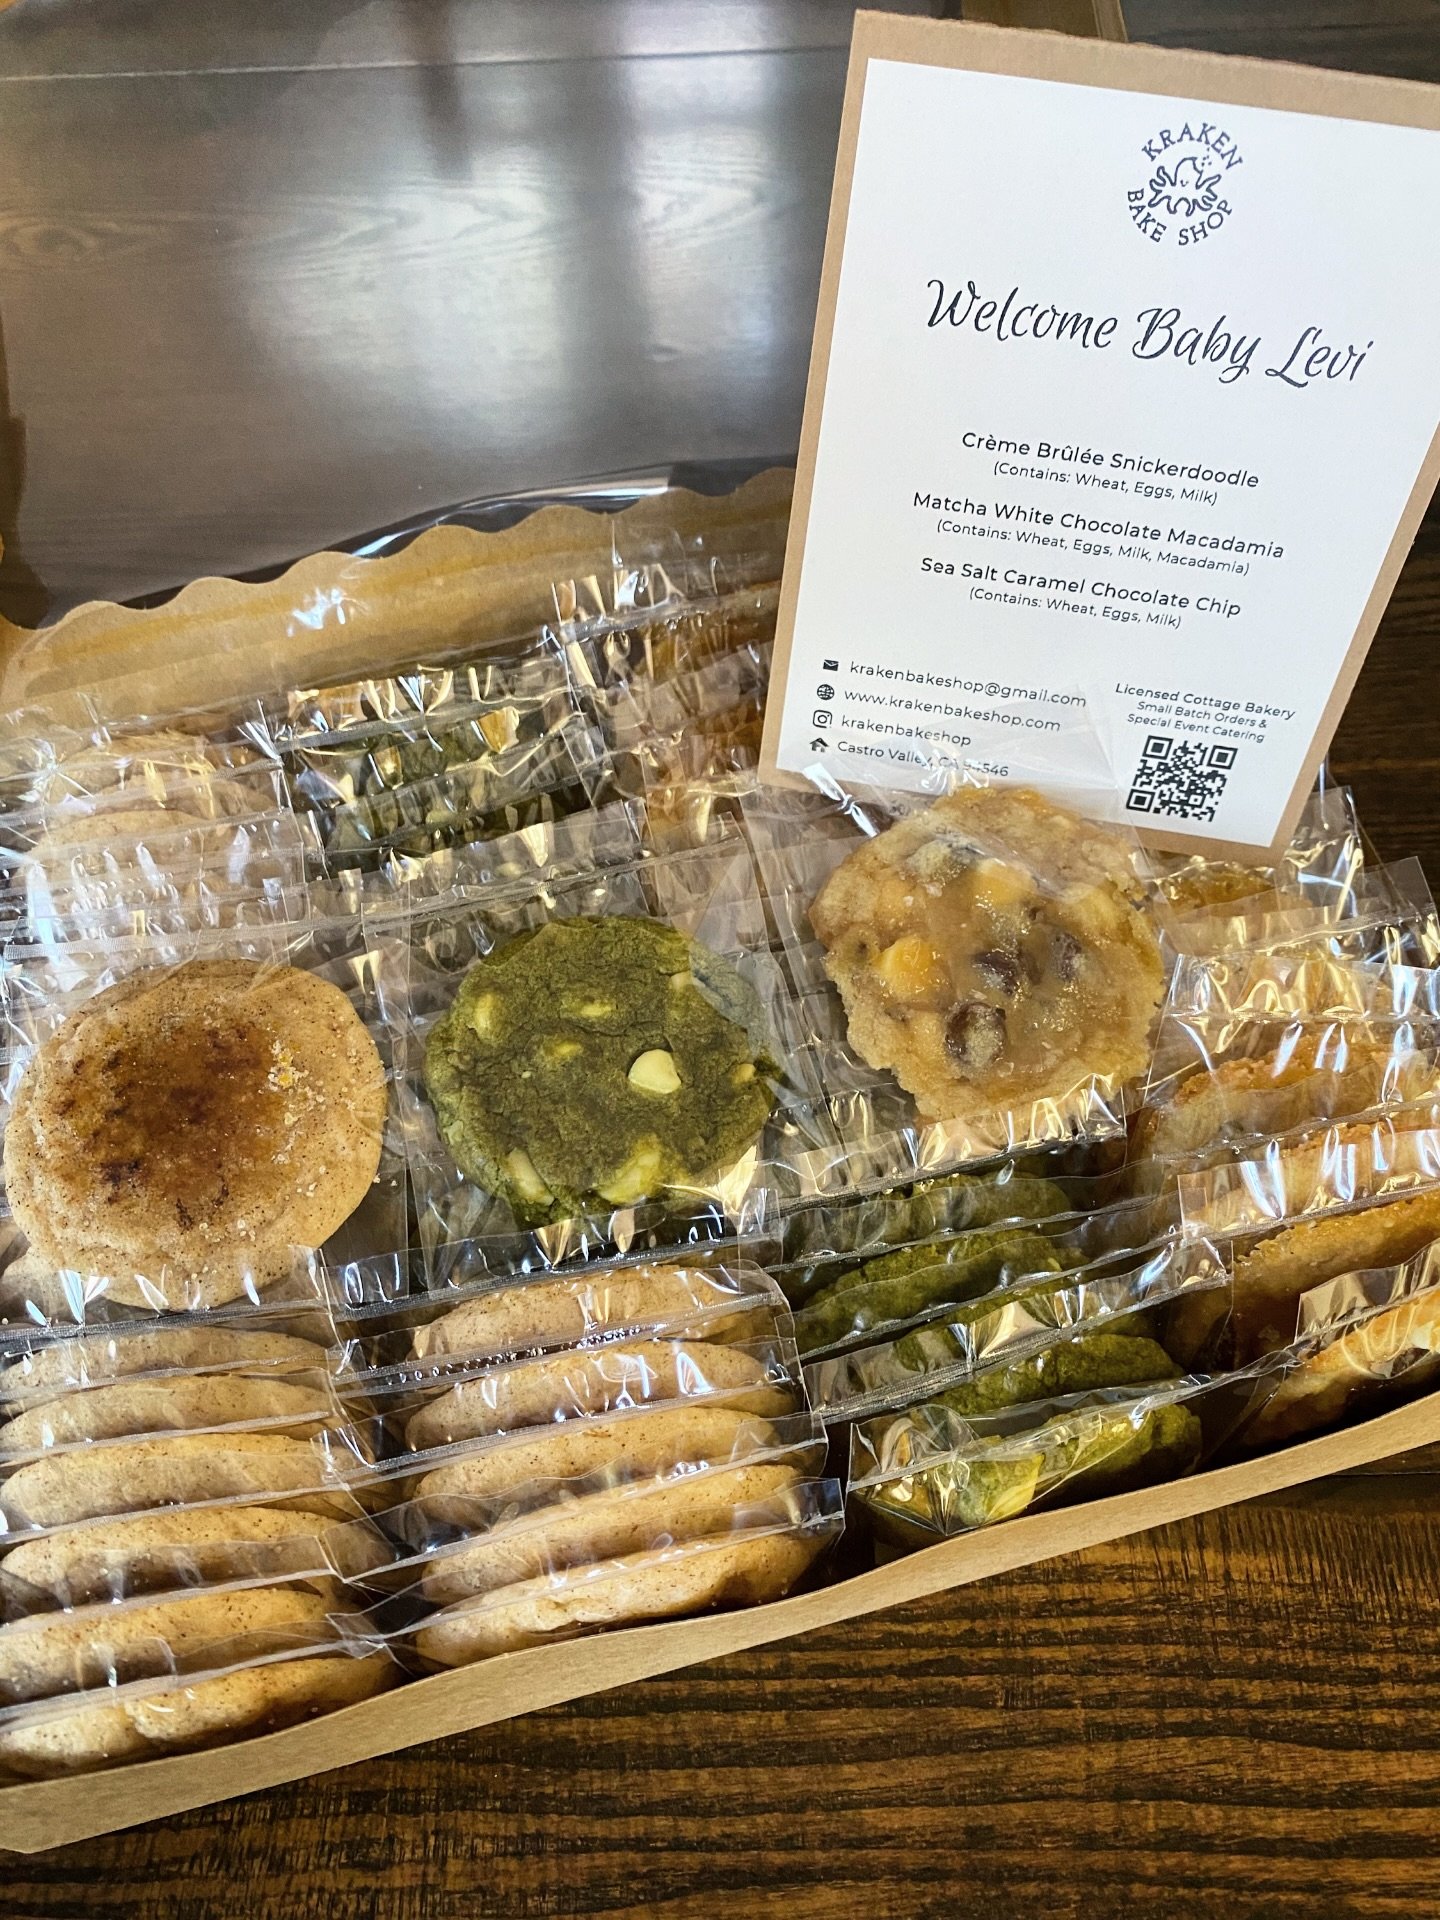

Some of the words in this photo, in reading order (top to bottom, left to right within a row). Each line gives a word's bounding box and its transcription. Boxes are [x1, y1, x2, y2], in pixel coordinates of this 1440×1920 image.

[1142, 122, 1243, 170] KRAKEN
[1127, 188, 1167, 242] BAKE
[1178, 200, 1232, 246] SHOP
[927, 279, 1118, 349] Welcome
[1132, 307, 1262, 384] Baby
[1265, 326, 1374, 388] Levi
[962, 432, 1030, 456] Crème
[1037, 442, 1104, 467] Brûlée
[1109, 453, 1259, 488] Snickerdoodle
[994, 461, 1071, 484] (Contains:
[1075, 473, 1129, 493] Wheat,
[1134, 482, 1176, 500] Eggs,
[1180, 488, 1218, 506] Milk)
[913, 492, 987, 516] Matcha
[995, 503, 1054, 526] White
[1060, 513, 1161, 541] Chocolate
[1168, 528, 1284, 559] Macadamia
[937, 519, 1012, 542] (Contains:
[1016, 531, 1068, 550] Wheat,
[1073, 539, 1114, 557] Eggs,
[1118, 545, 1152, 562] Milk,
[1157, 551, 1250, 576] Macadamia)
[921, 558, 955, 575] Sea
[961, 563, 998, 581] Salt
[1003, 569, 1085, 594] Caramel
[1091, 582, 1189, 608] Chocolate
[1196, 597, 1241, 618] Chip
[969, 587, 1042, 610] (Contains:
[1046, 599, 1098, 618] Wheat,
[1102, 606, 1141, 624] Eggs,
[1146, 612, 1182, 629] Milk)
[850, 661, 1087, 708] krakenbakeshop@gmail.com
[1115, 683, 1180, 701] Licensed
[1183, 693, 1241, 711] Cottage
[1244, 702, 1296, 721] Bakery
[841, 715, 972, 747] krakenbakeshop
[844, 690, 1061, 732] www.krakenbakeshop.com
[1127, 713, 1171, 727] Special
[1174, 721, 1209, 734] Event
[1212, 726, 1265, 744] Catering
[1137, 701, 1173, 714] Small
[1175, 707, 1211, 720] Batch
[1214, 713, 1256, 727] Orders
[1258, 720, 1267, 729] &
[837, 741, 884, 757] Castro
